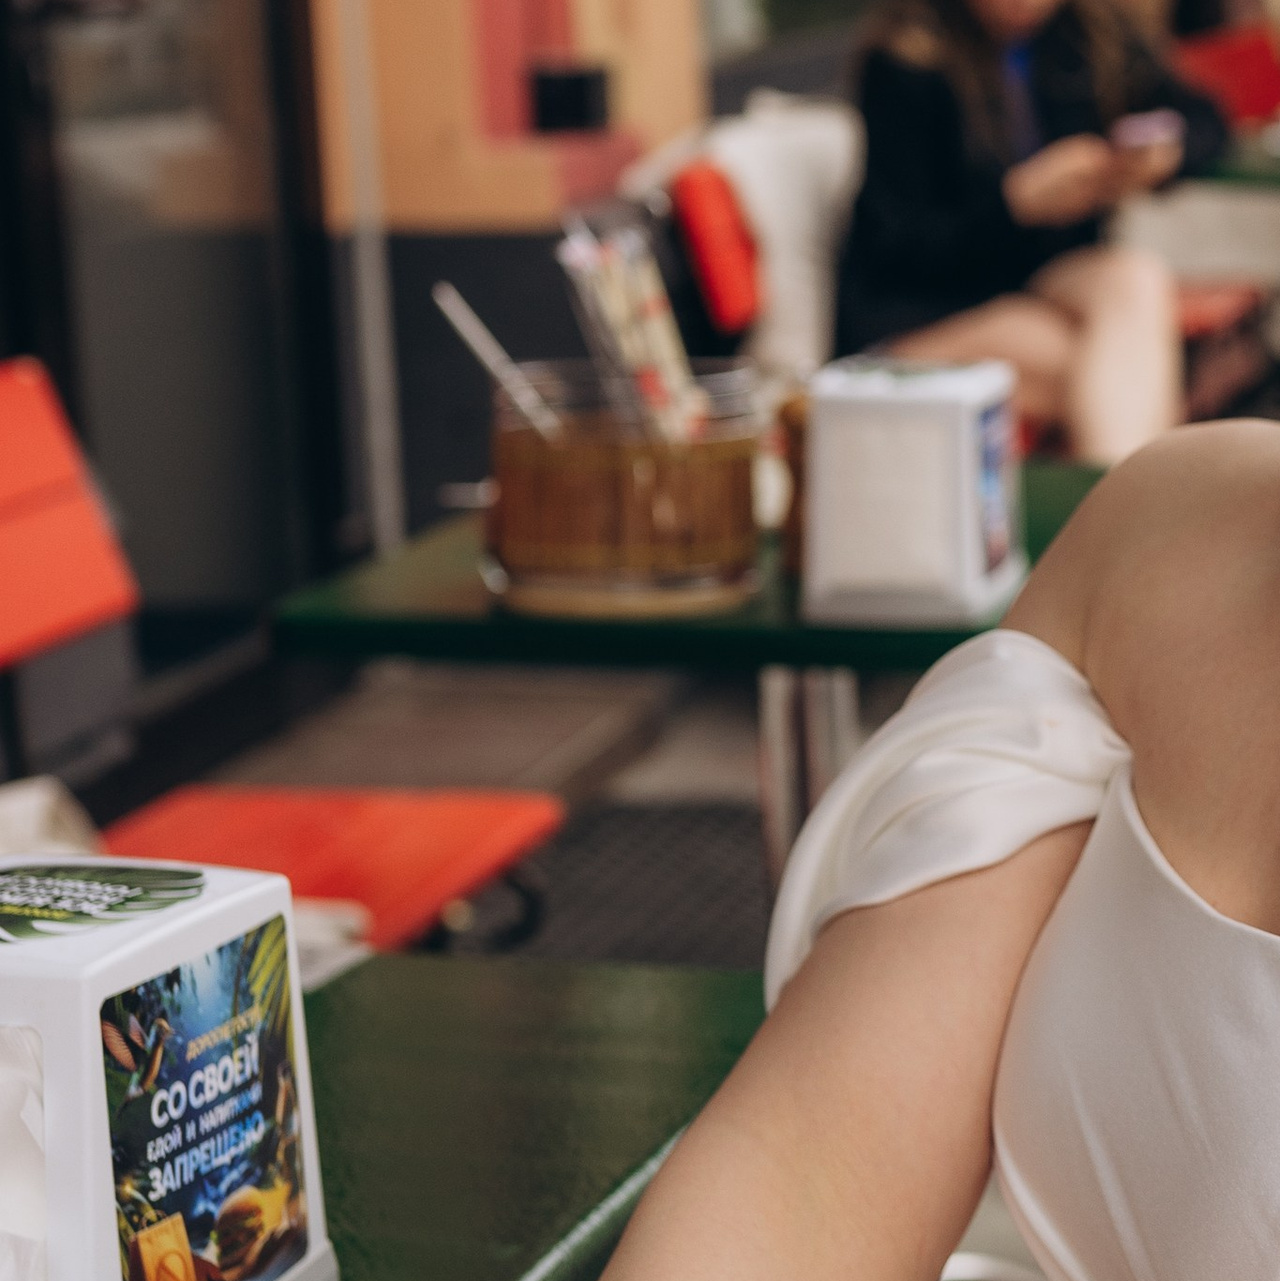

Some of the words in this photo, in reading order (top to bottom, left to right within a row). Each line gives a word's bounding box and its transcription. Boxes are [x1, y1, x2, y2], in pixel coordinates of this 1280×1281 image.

[150, 1080, 187, 1128] СО
[188, 1032, 260, 1109] СВОЕЙ
[146, 1123, 183, 1163] ЕДОЙ
[185, 1119, 197, 1143] И
[147, 1110, 265, 1202] ЗАПРЕЩЕНО
